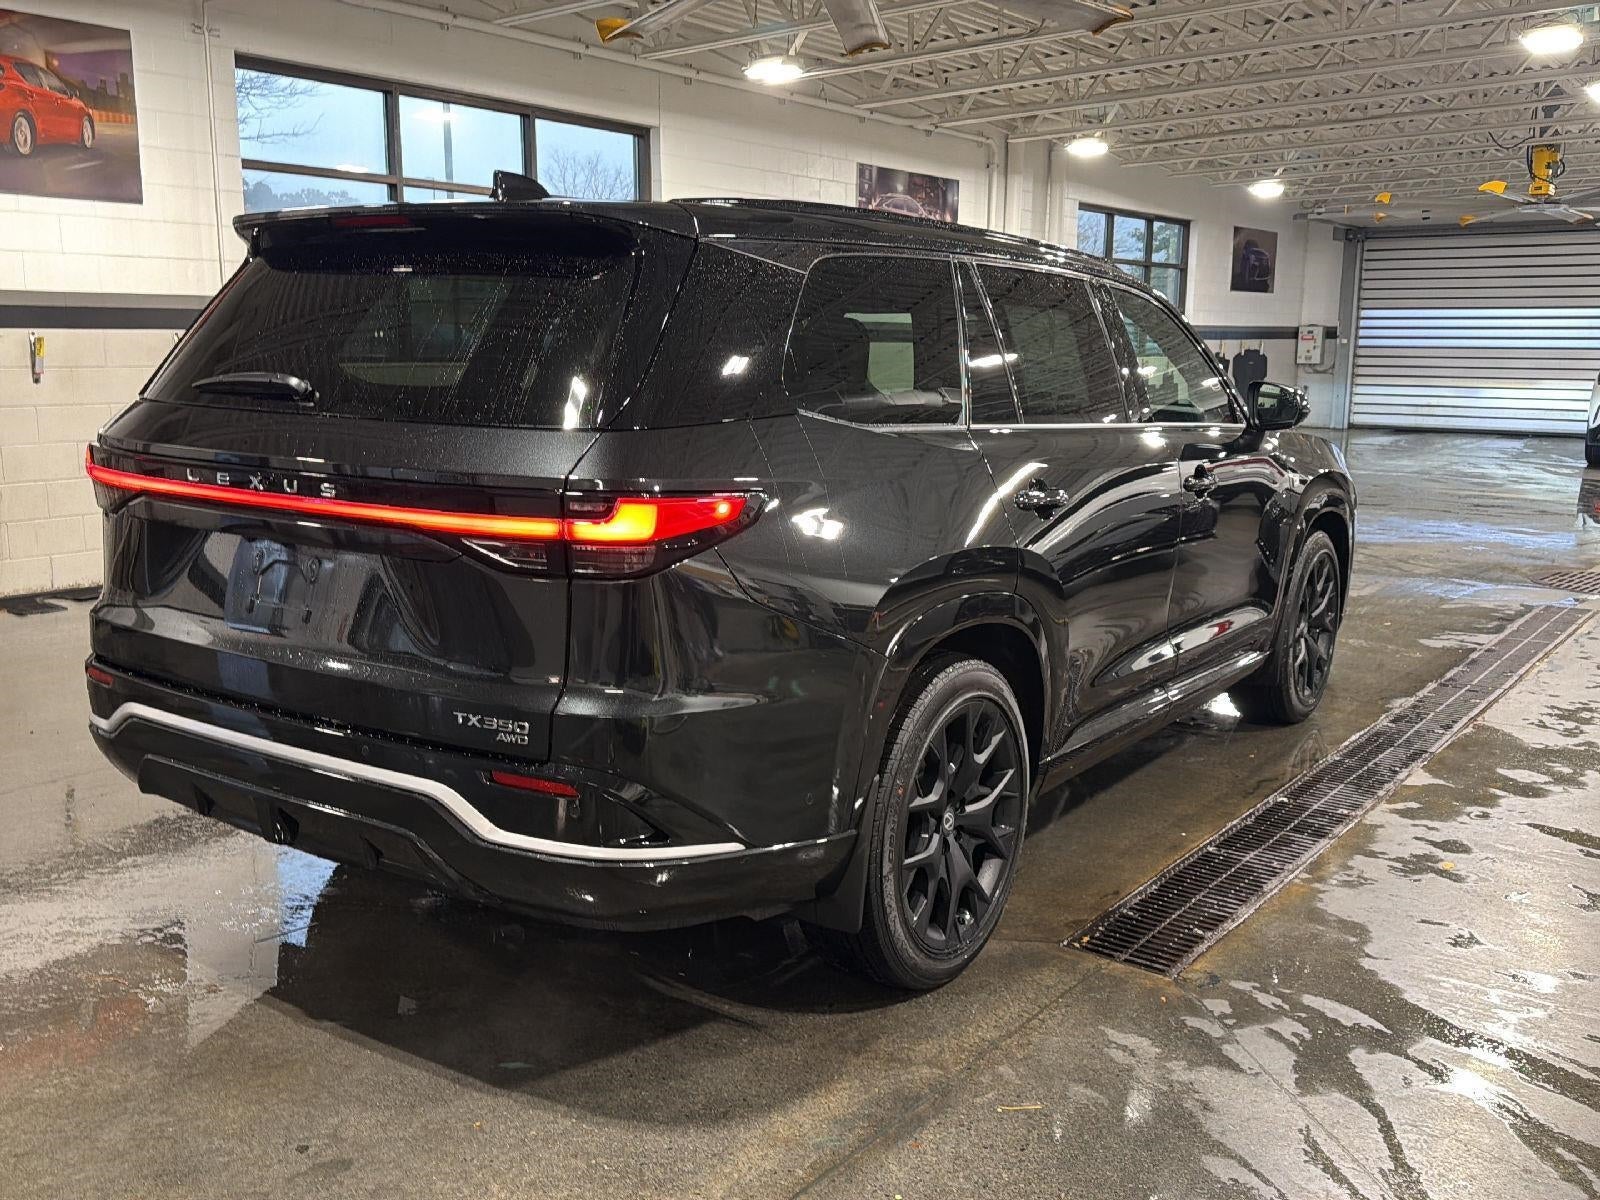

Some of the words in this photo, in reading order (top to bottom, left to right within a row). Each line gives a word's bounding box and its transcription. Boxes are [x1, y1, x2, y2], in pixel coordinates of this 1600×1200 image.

[186, 467, 336, 498] LEXUS
[453, 711, 530, 735] TX350
[496, 732, 529, 745] AWD
